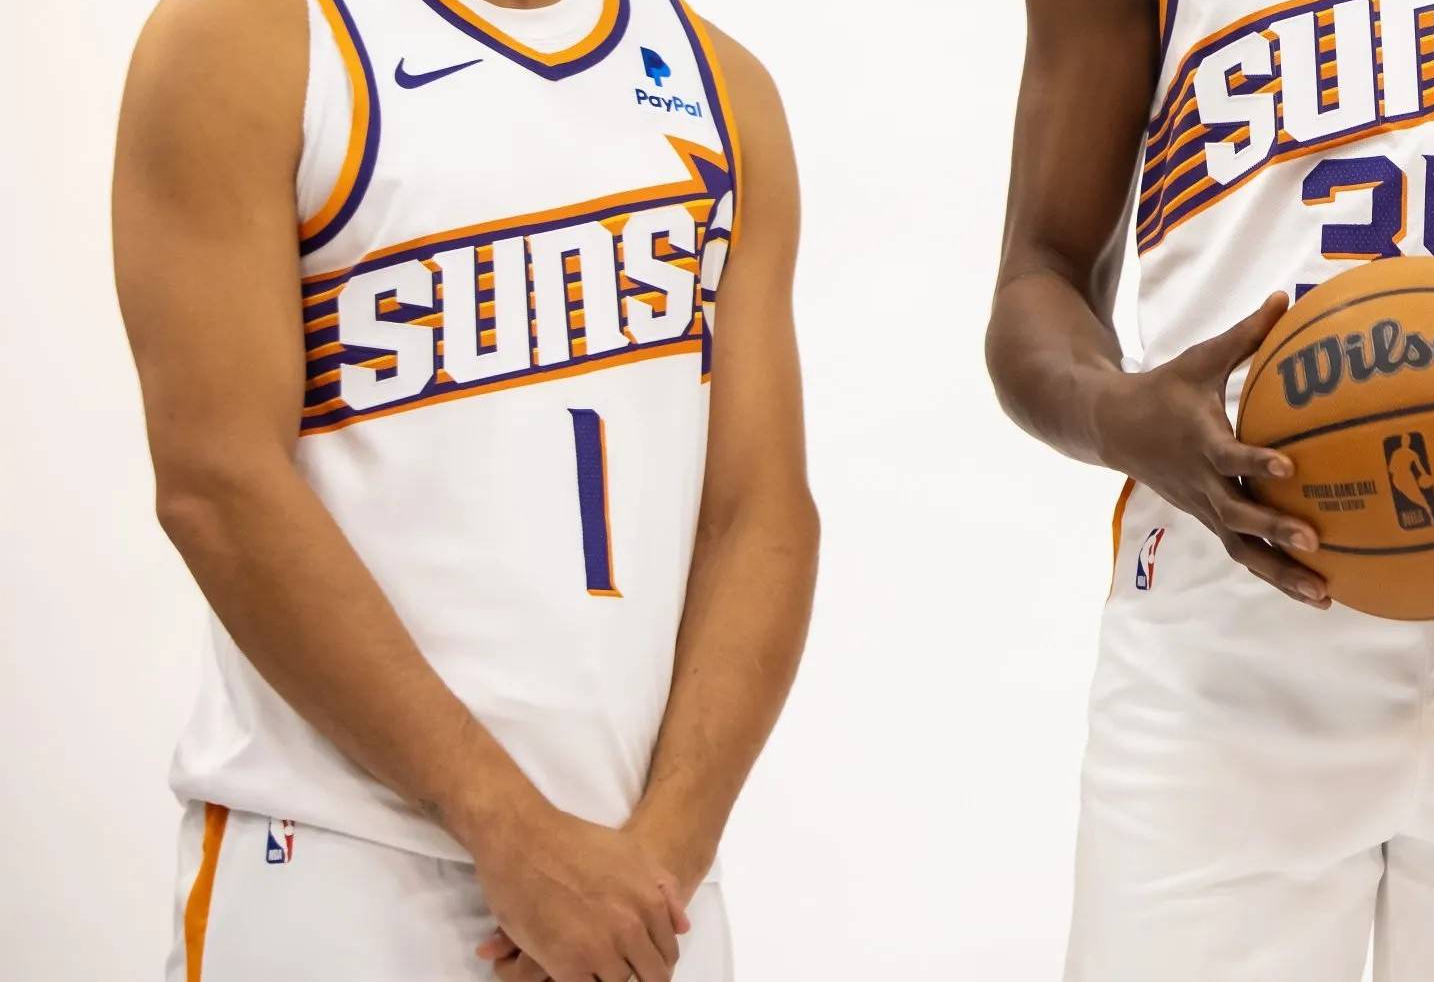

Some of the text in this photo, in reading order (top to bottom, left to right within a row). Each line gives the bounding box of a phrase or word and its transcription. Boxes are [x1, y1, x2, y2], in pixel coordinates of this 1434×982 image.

[635, 88, 703, 118] PayPal
[337, 204, 696, 412] SUNS
[567, 408, 624, 598] 1
